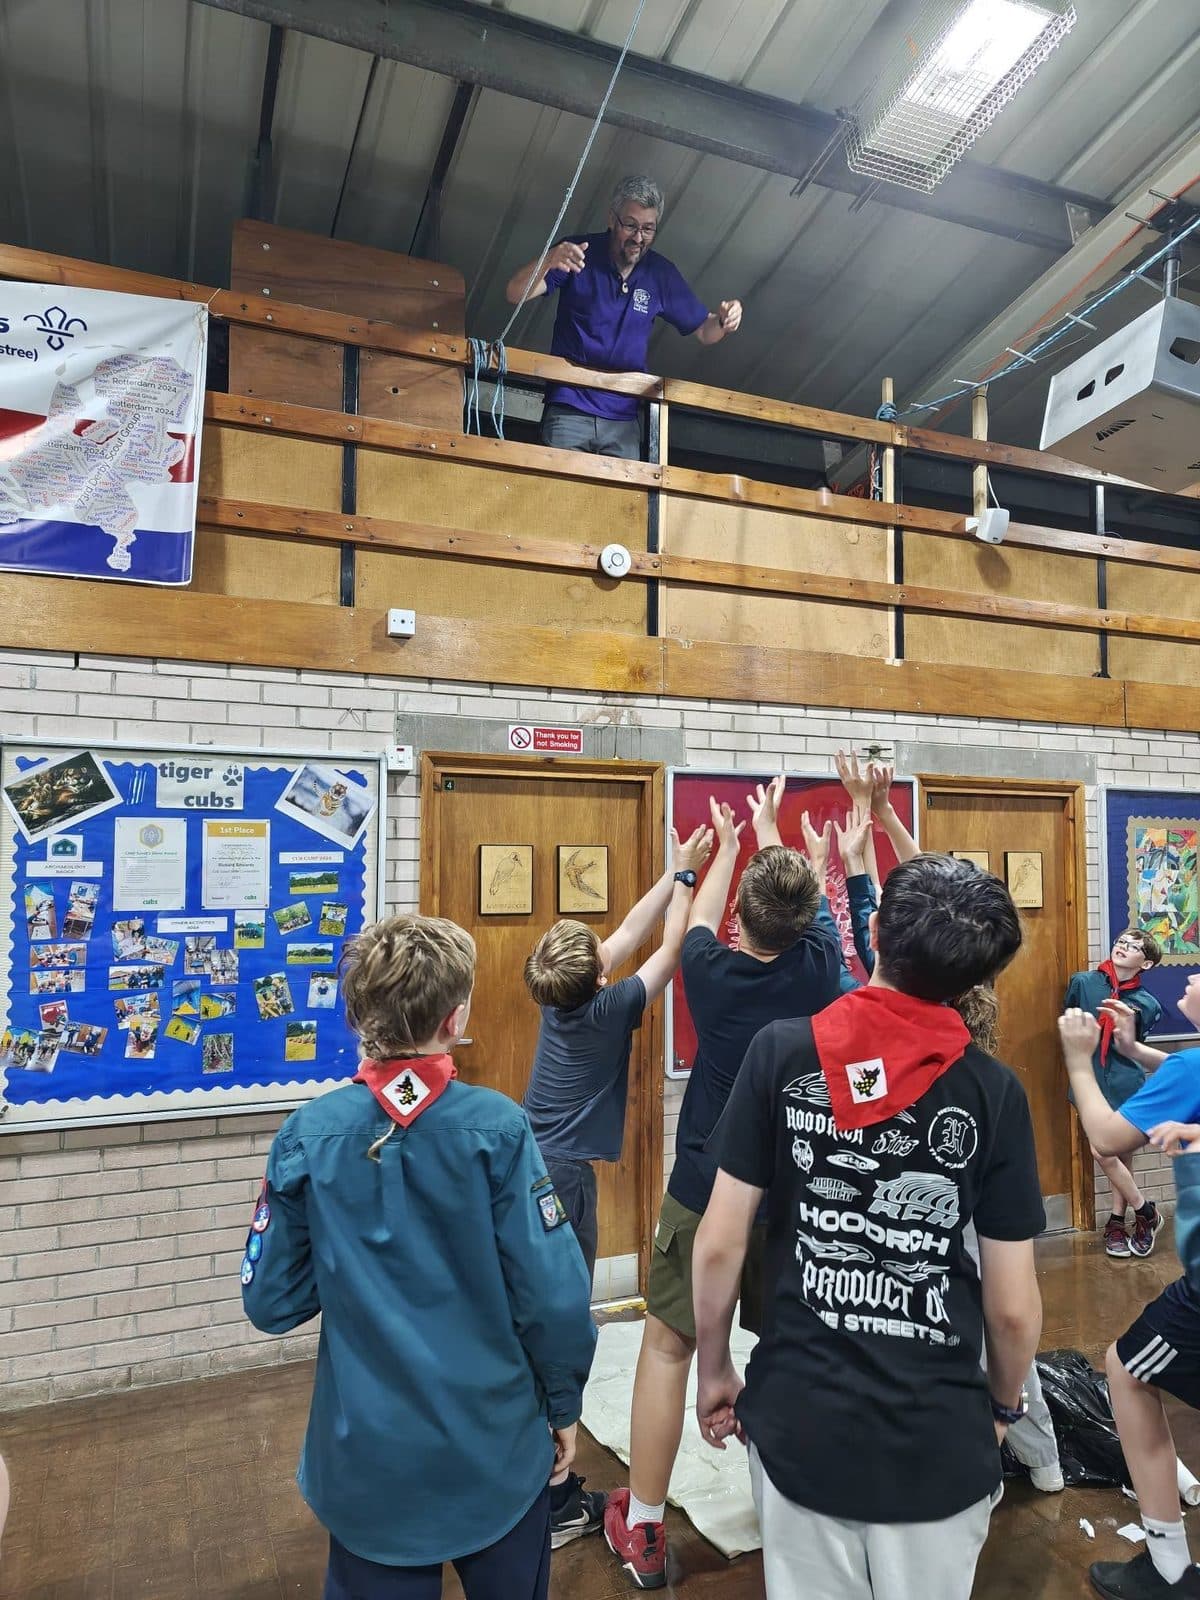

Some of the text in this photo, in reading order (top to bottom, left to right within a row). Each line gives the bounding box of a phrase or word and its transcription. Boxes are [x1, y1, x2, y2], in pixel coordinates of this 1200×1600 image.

[112, 377, 177, 393] Rotterdam 2024
[110, 399, 153, 413] Rotterdam
[154, 406, 175, 417] 2024
[78, 484, 94, 506] 73rd
[90, 461, 111, 486] Derby
[105, 436, 125, 461] Scout
[121, 412, 141, 438] Group
[84, 447, 105, 456] 2024
[535, 731, 555, 739] Thank
[550, 741, 578, 750] Smoking
[158, 761, 213, 784] tiger
[183, 791, 234, 808] cubs
[220, 826, 255, 834] 1st Place
[799, 1201, 950, 1257] HOODRCH
[844, 1313, 946, 1344] STREETS
